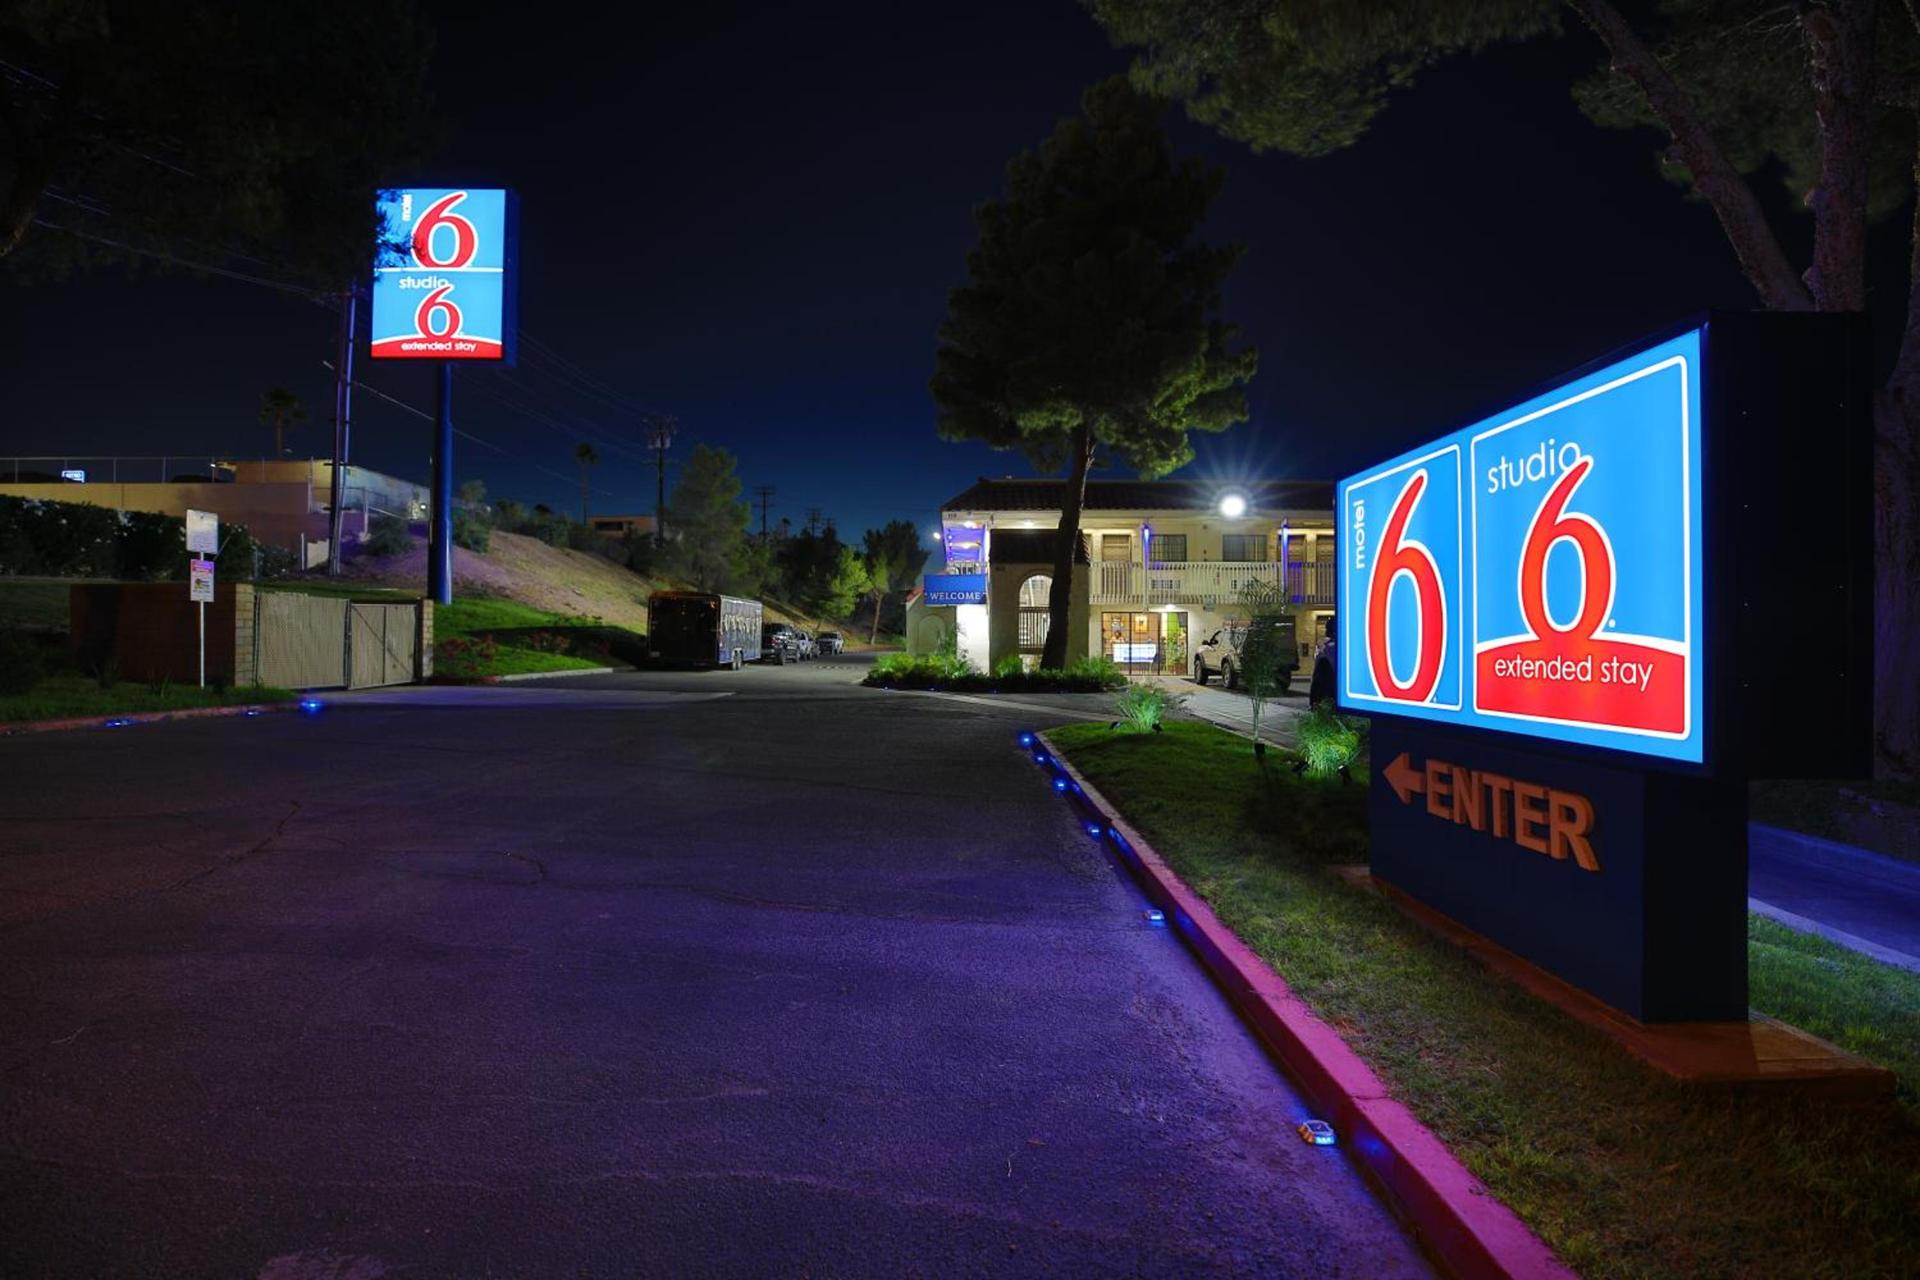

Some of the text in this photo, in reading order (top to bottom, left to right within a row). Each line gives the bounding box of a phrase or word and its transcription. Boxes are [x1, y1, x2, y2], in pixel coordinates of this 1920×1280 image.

[411, 191, 478, 268] 6
[400, 276, 450, 288] studio
[415, 284, 463, 338] 6
[401, 341, 476, 352] extended stay
[1488, 439, 1580, 493] studio
[1353, 500, 1364, 569] motel
[1519, 455, 1616, 640] 6
[930, 592, 981, 600] WELCOME
[1366, 469, 1447, 703] 6
[1494, 655, 1653, 691] extended stay
[1426, 759, 1600, 871] ENTER
